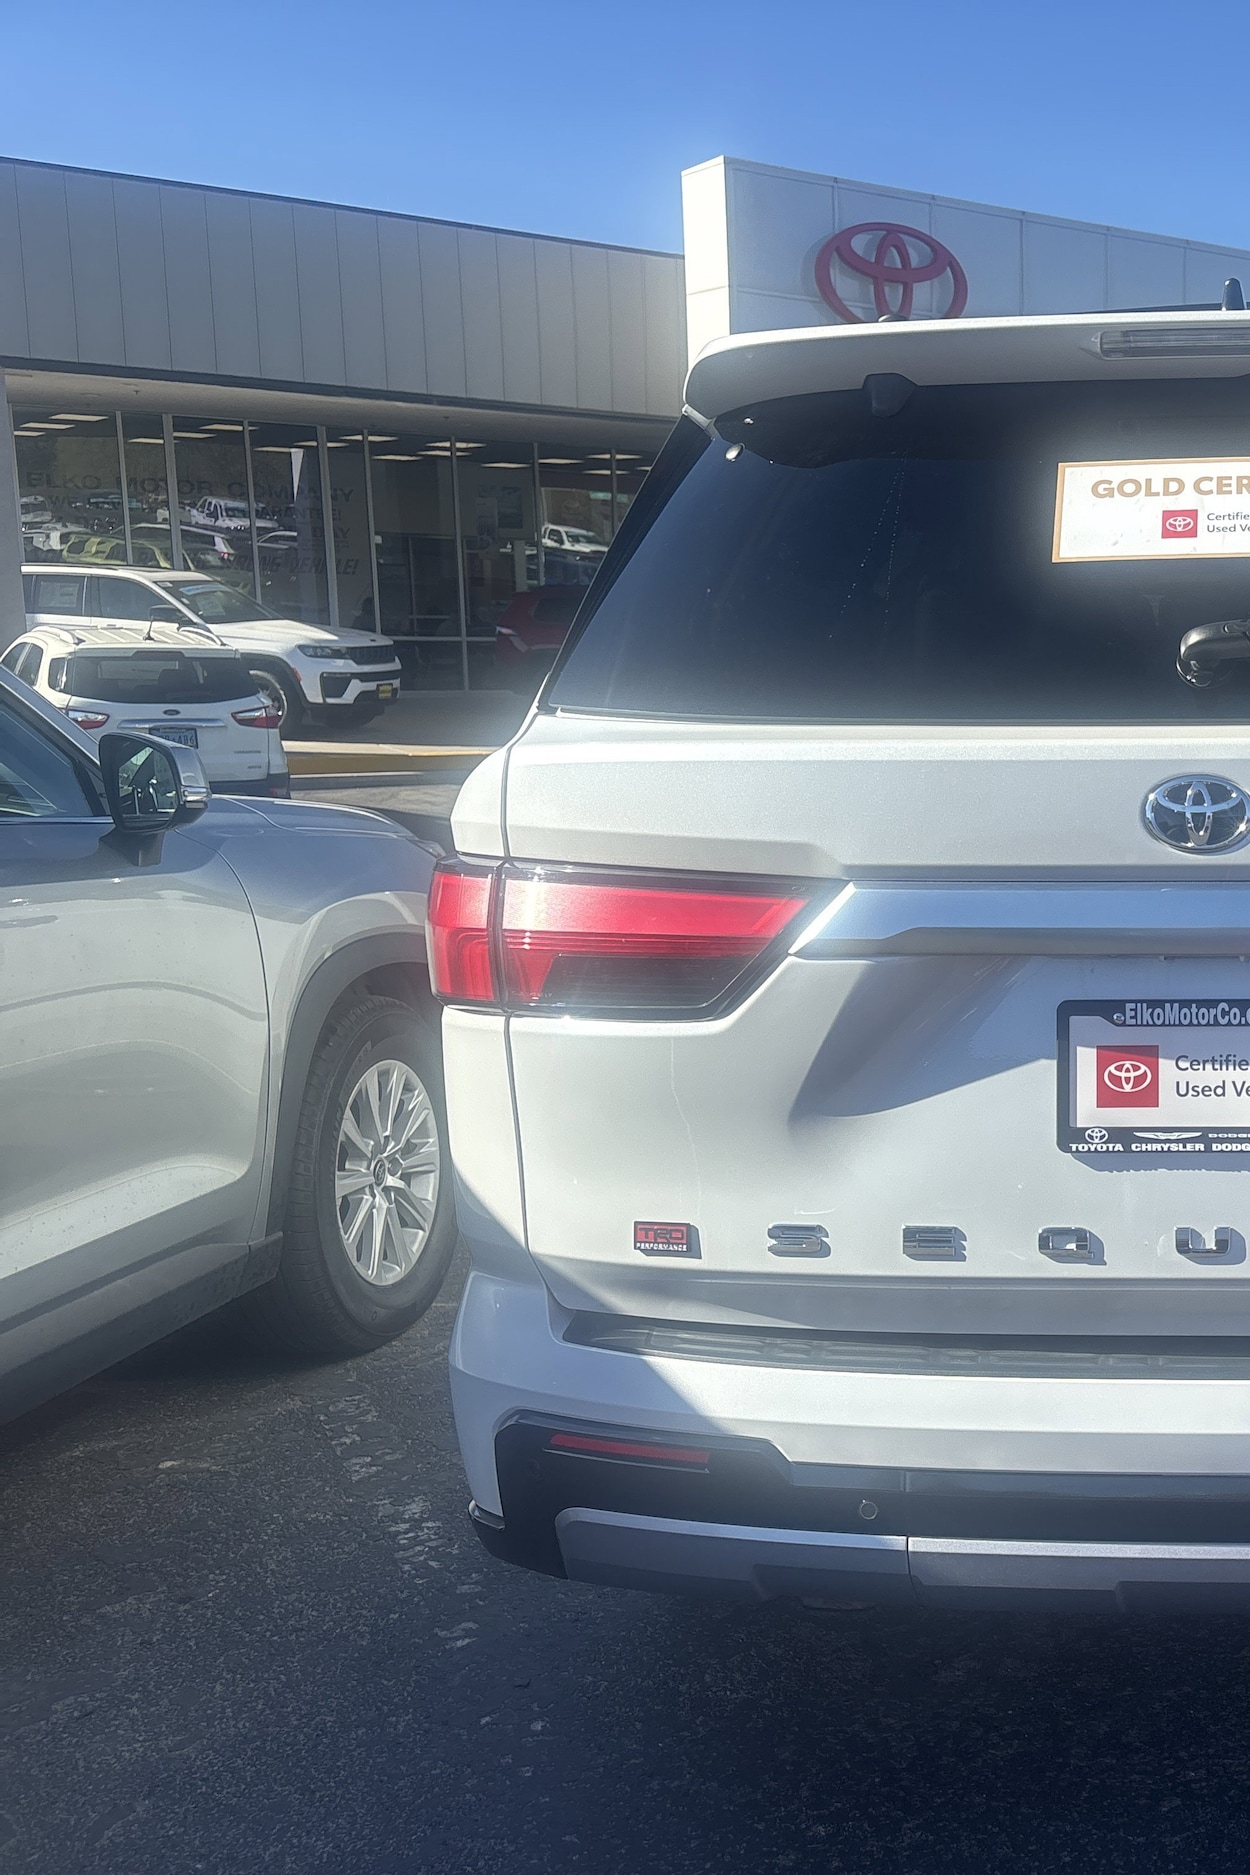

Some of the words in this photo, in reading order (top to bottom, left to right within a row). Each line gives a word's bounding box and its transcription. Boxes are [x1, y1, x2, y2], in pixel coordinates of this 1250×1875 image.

[26, 471, 100, 489] ELKO
[1090, 477, 1186, 499] GOLD
[1206, 522, 1237, 533] Used
[1175, 1080, 1226, 1098] Used
[1069, 1143, 1124, 1152] TOYOTA
[1131, 1143, 1205, 1152] CHRYSLER
[638, 1227, 685, 1243] TRD
[635, 1242, 688, 1252] PERFORMANCE
